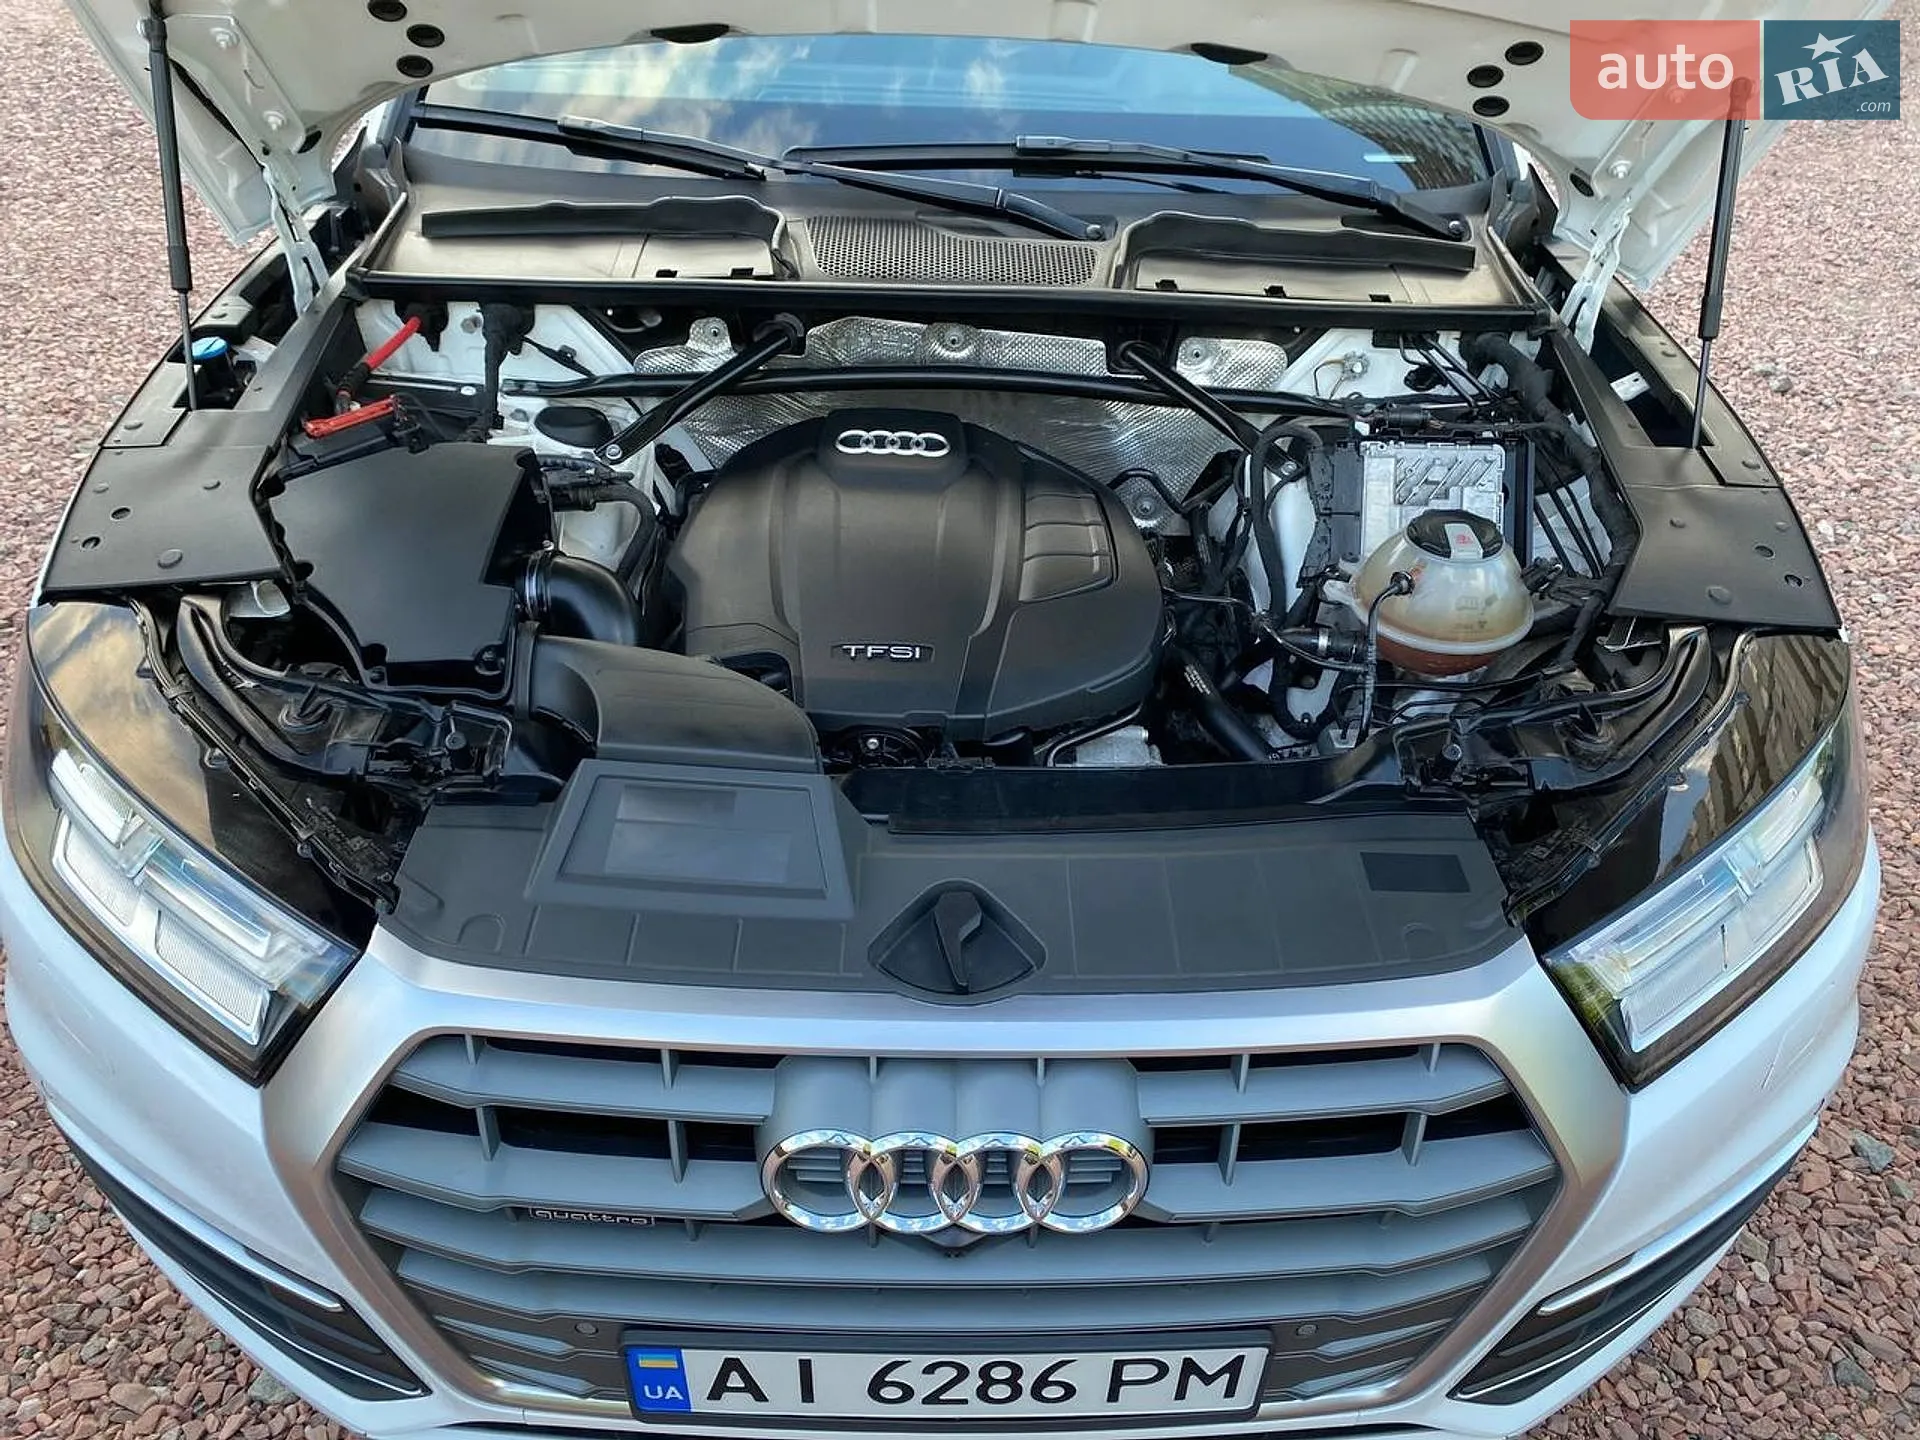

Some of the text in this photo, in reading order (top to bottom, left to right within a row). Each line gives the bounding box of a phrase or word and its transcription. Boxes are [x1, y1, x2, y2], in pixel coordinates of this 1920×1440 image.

[842, 644, 920, 659] TFSI
[535, 1209, 648, 1225] quattro
[706, 1354, 1246, 1405] AI 6286 PM
[644, 1386, 684, 1401] UA
